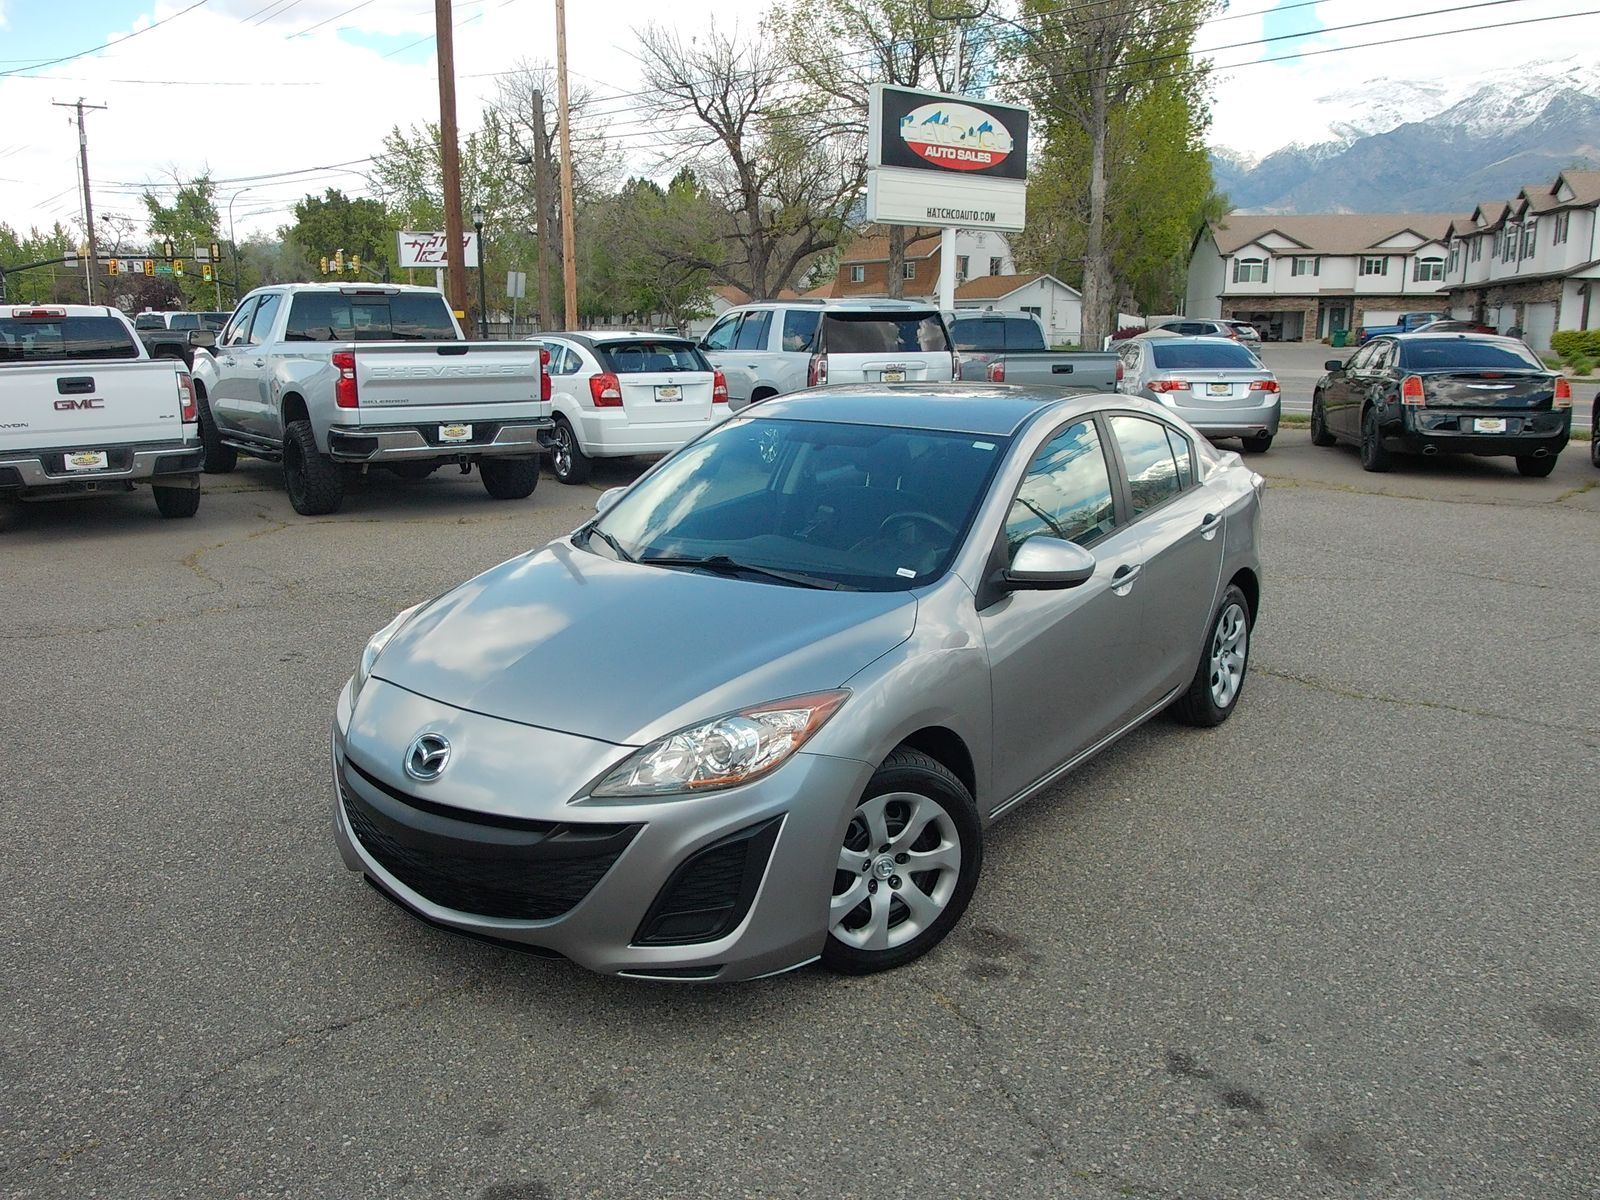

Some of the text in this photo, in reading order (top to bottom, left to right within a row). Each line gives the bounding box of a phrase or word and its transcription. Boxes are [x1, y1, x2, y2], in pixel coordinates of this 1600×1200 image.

[924, 146, 992, 163] AUTO SALES
[926, 207, 996, 222] HATCHCOAUTO.COM
[371, 365, 529, 377] CHEVROLET
[54, 399, 104, 411] GMC
